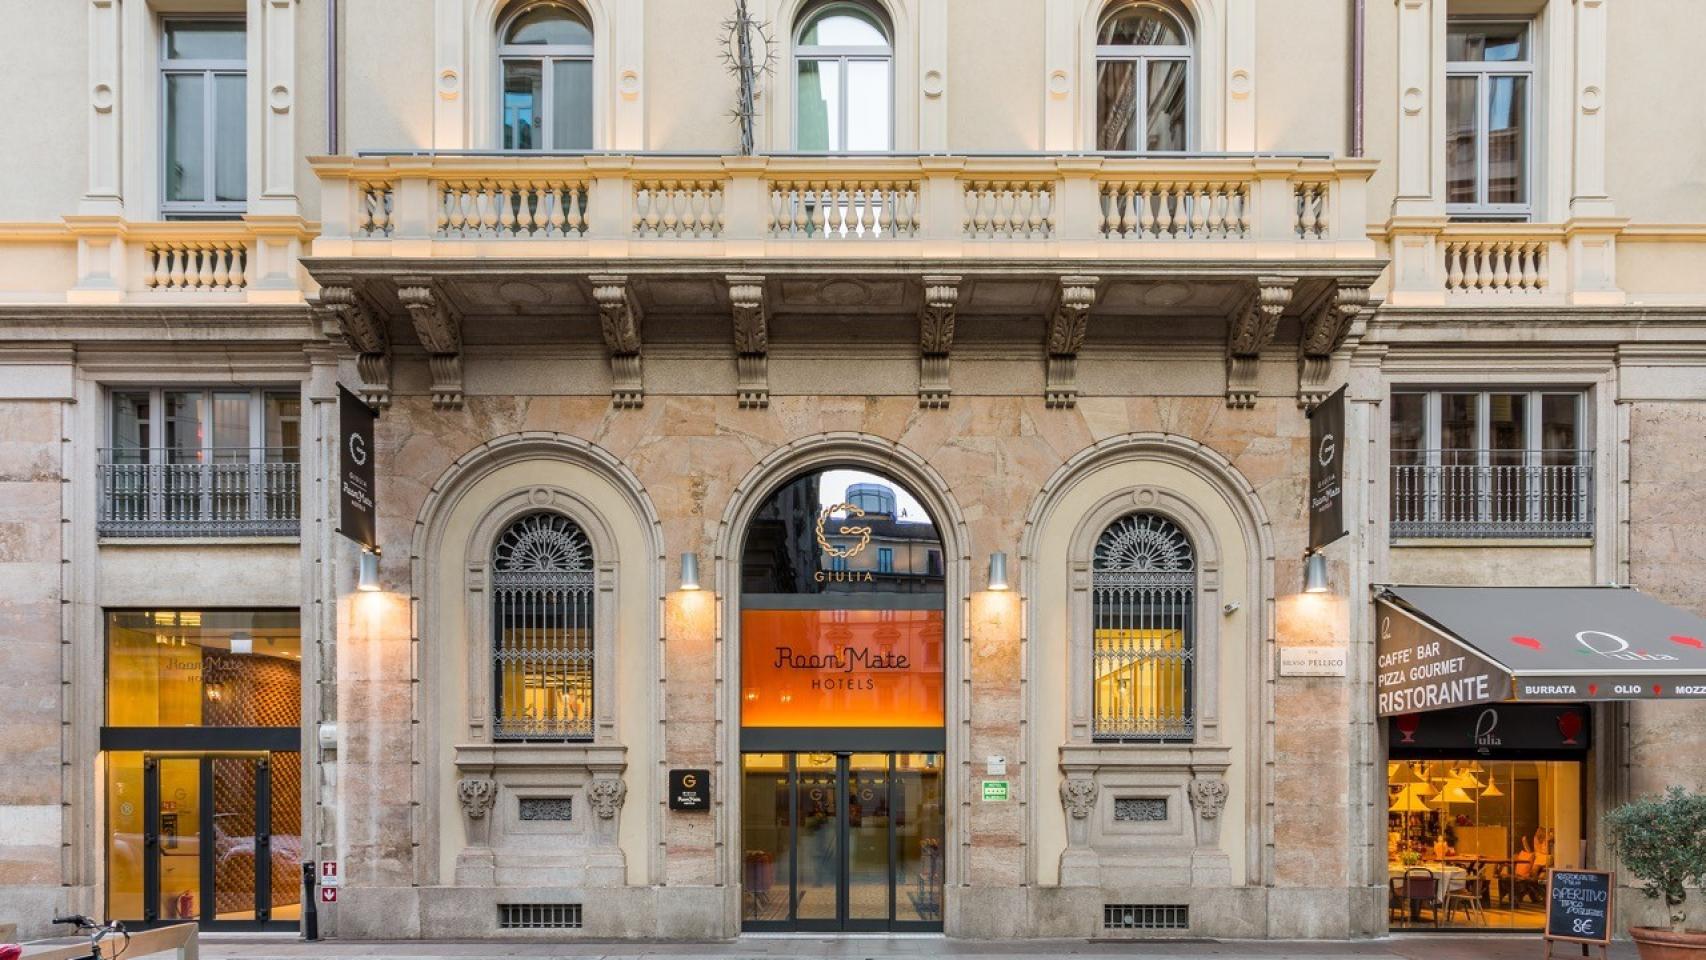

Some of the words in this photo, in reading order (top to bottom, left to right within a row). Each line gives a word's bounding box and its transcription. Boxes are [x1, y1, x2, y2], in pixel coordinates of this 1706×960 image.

[814, 571, 874, 583] GIULIA
[774, 647, 844, 669] Room
[842, 647, 911, 673] Mate
[1378, 648, 1412, 668] CAFFE'
[1417, 642, 1440, 658] BAR
[1378, 671, 1406, 687] PIZZA
[1410, 657, 1466, 681] GOURMET
[812, 679, 875, 690] HOTELS
[1525, 685, 1577, 694] BURRATA
[1614, 685, 1642, 694] OLIO
[1675, 685, 1706, 694] MOZZ
[1379, 675, 1489, 714] RISTORANTE
[1475, 708, 1502, 745] Pulia
[683, 774, 697, 788] G
[1552, 887, 1607, 902] APERITIVO
[1572, 918, 1595, 934] 8€
